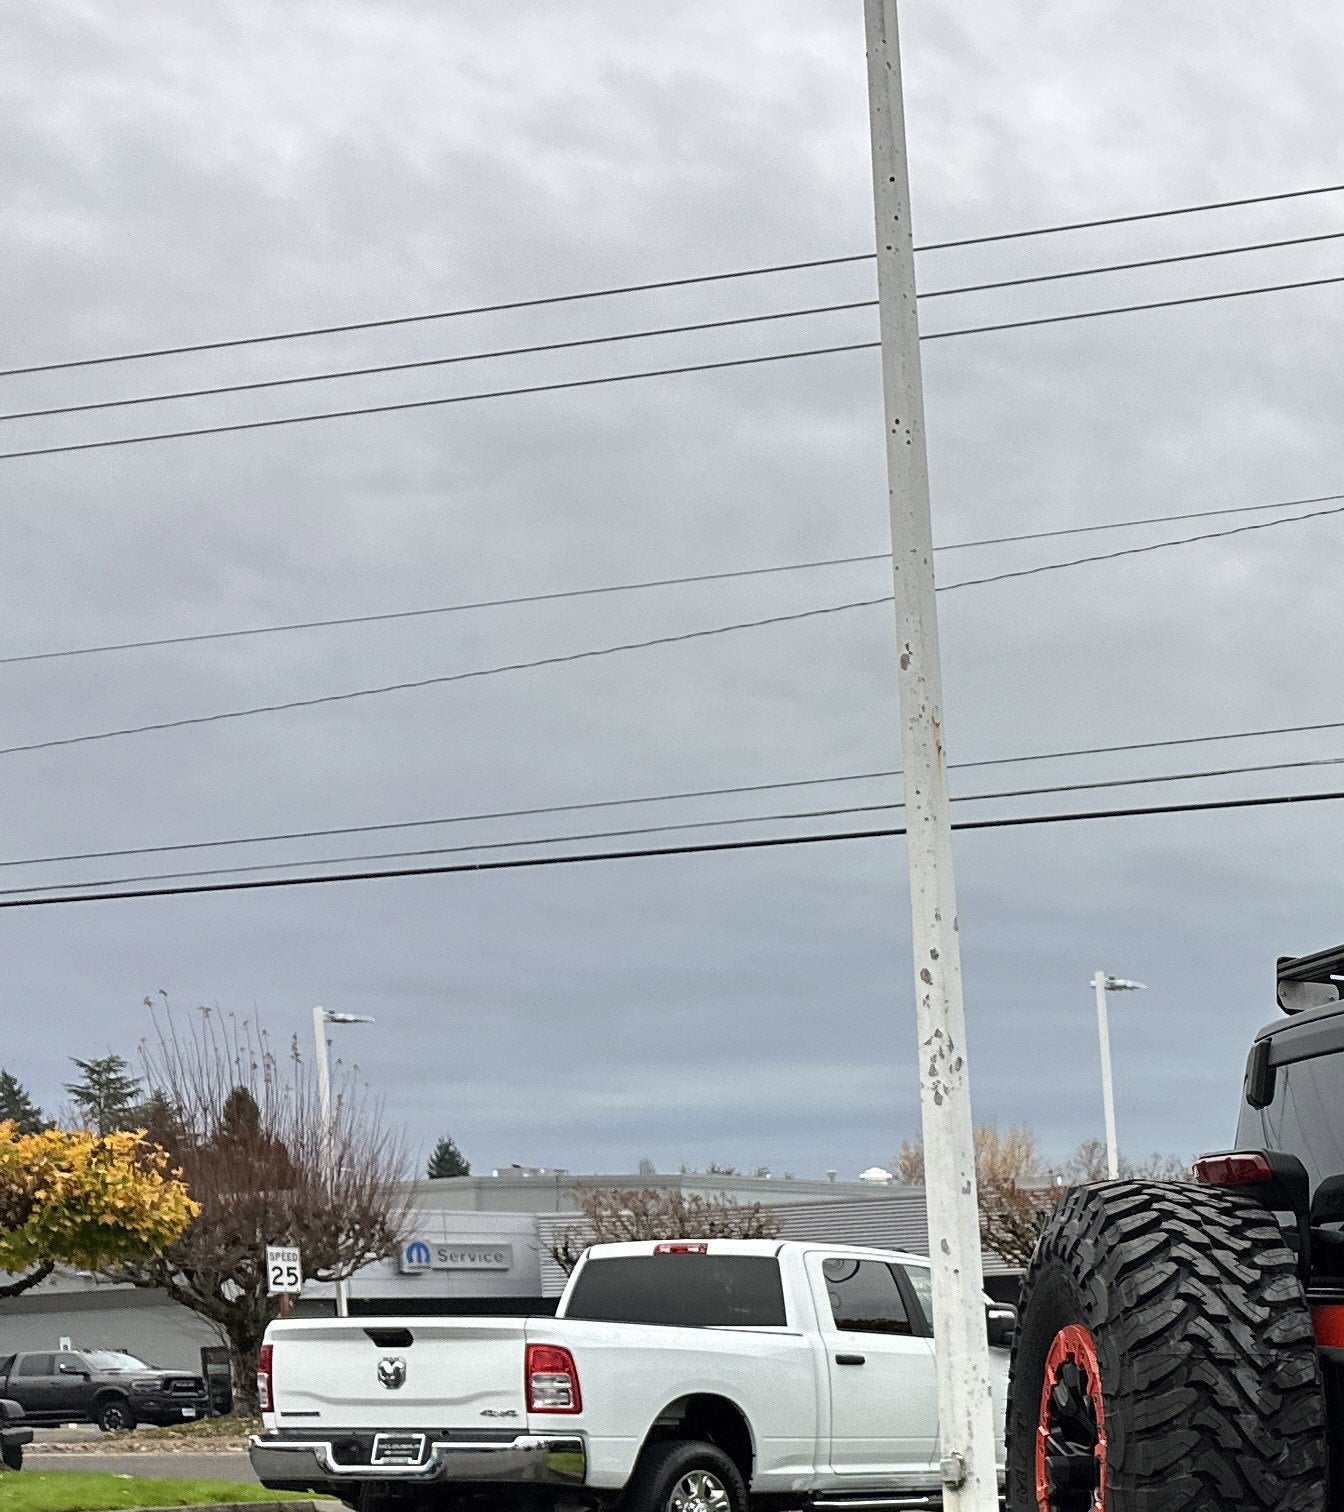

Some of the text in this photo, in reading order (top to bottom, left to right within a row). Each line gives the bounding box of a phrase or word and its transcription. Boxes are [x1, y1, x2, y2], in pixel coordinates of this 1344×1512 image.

[269, 1251, 299, 1262] SPEED
[437, 1249, 505, 1263] Service
[271, 1266, 300, 1287] 25
